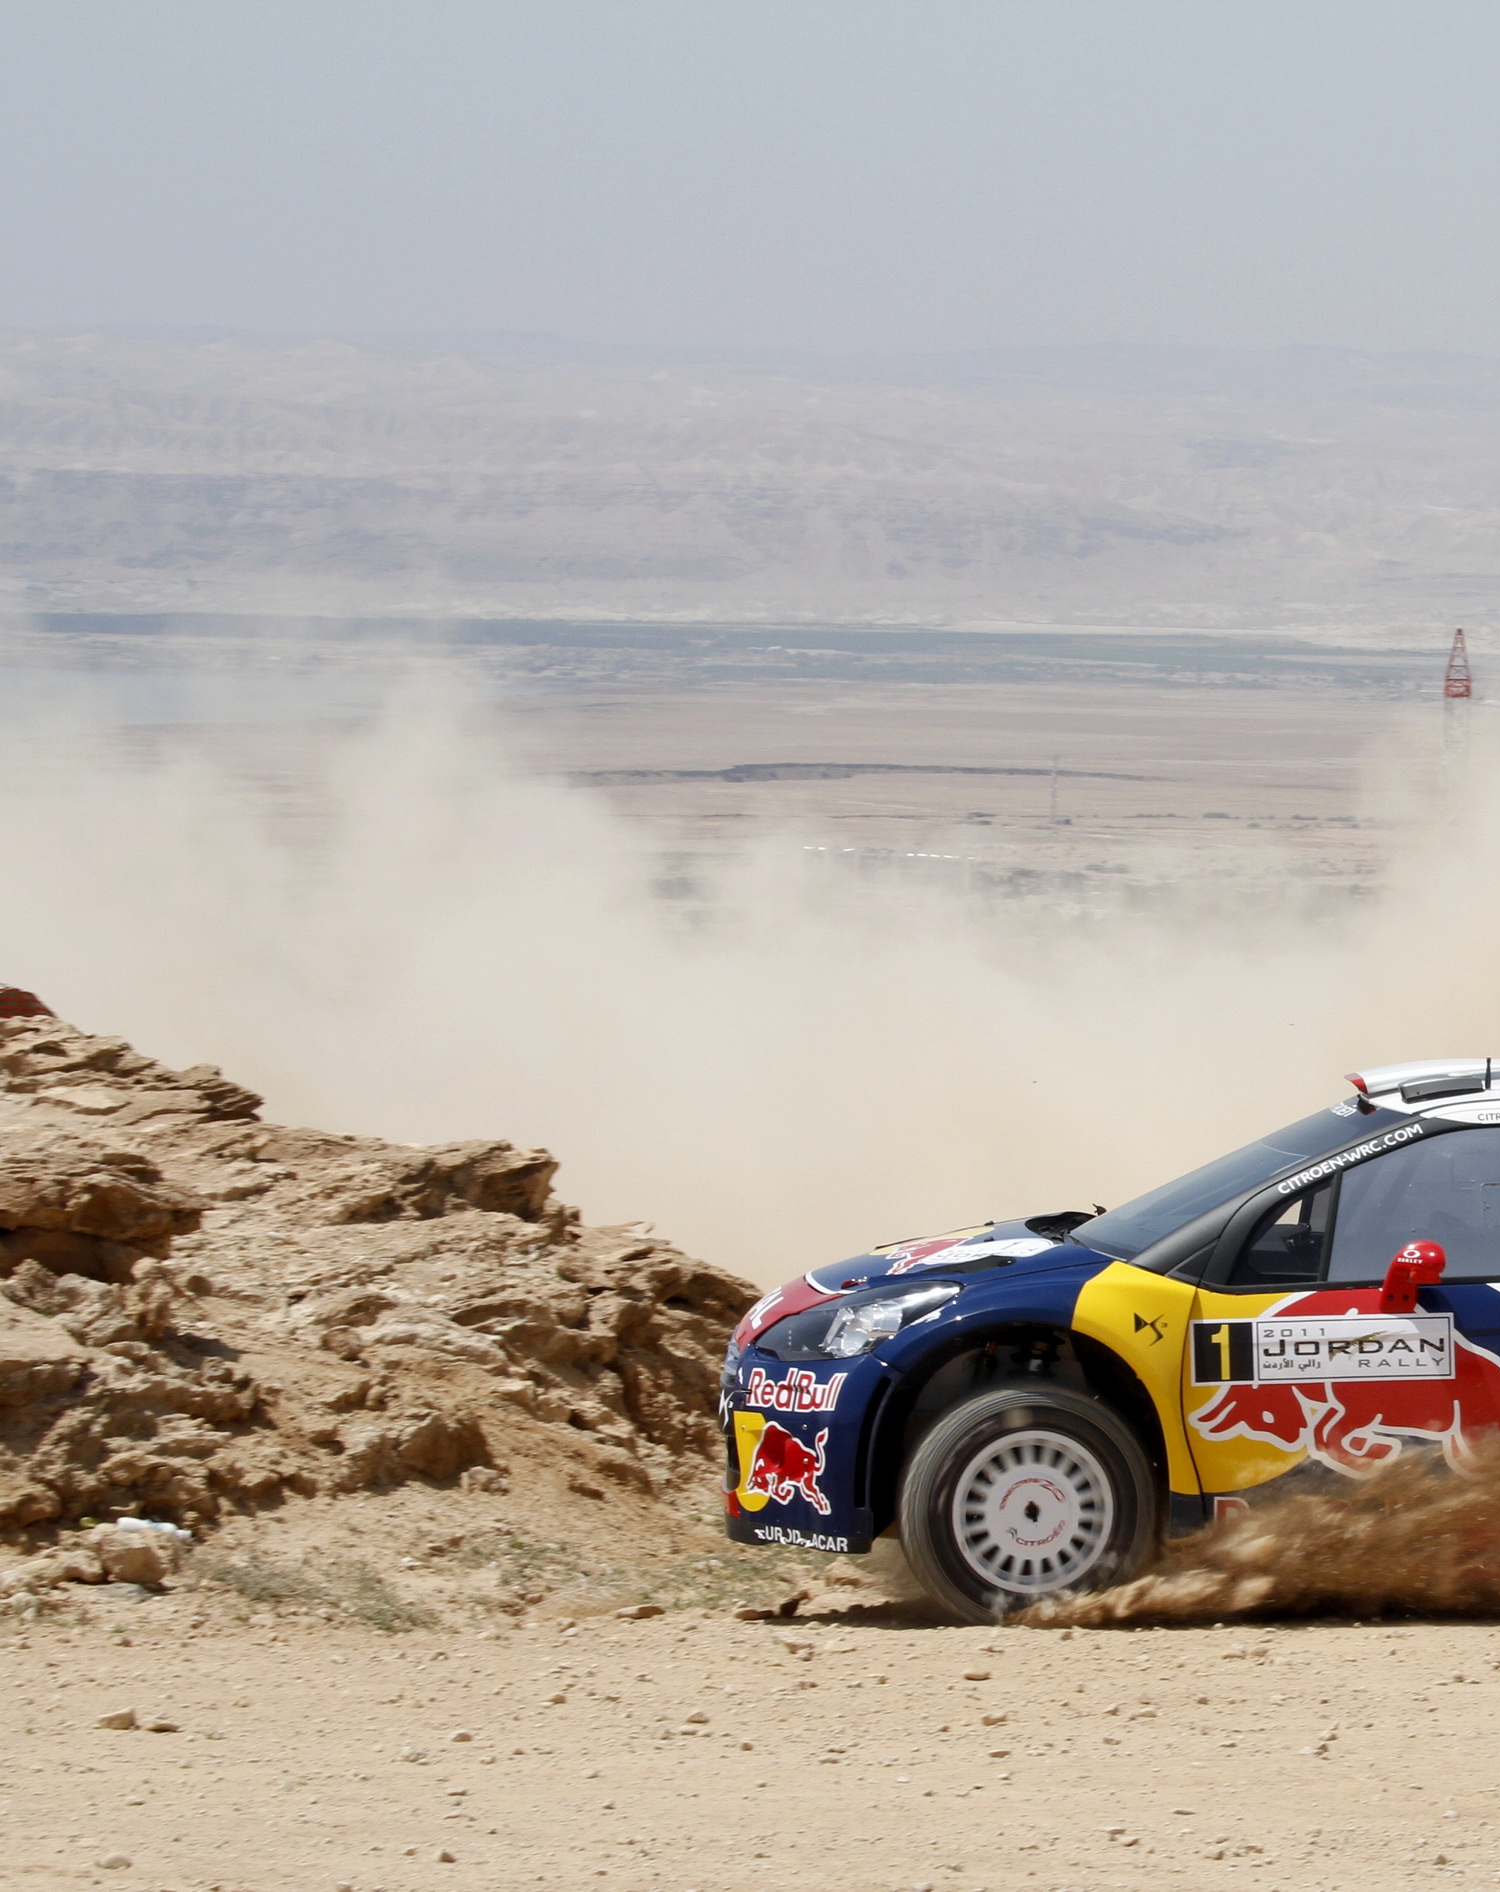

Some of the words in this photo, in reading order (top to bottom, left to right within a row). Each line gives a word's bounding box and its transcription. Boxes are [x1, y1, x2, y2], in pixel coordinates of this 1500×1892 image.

[1278, 1123, 1424, 1194] CITROEN-WRC.COM
[1263, 1328, 1326, 1338] 2011
[1263, 1338, 1445, 1357] JORDAN
[1211, 1324, 1231, 1380] 1
[1358, 1357, 1445, 1368] RALLY
[746, 1367, 799, 1412] Red
[794, 1369, 848, 1413] Bull
